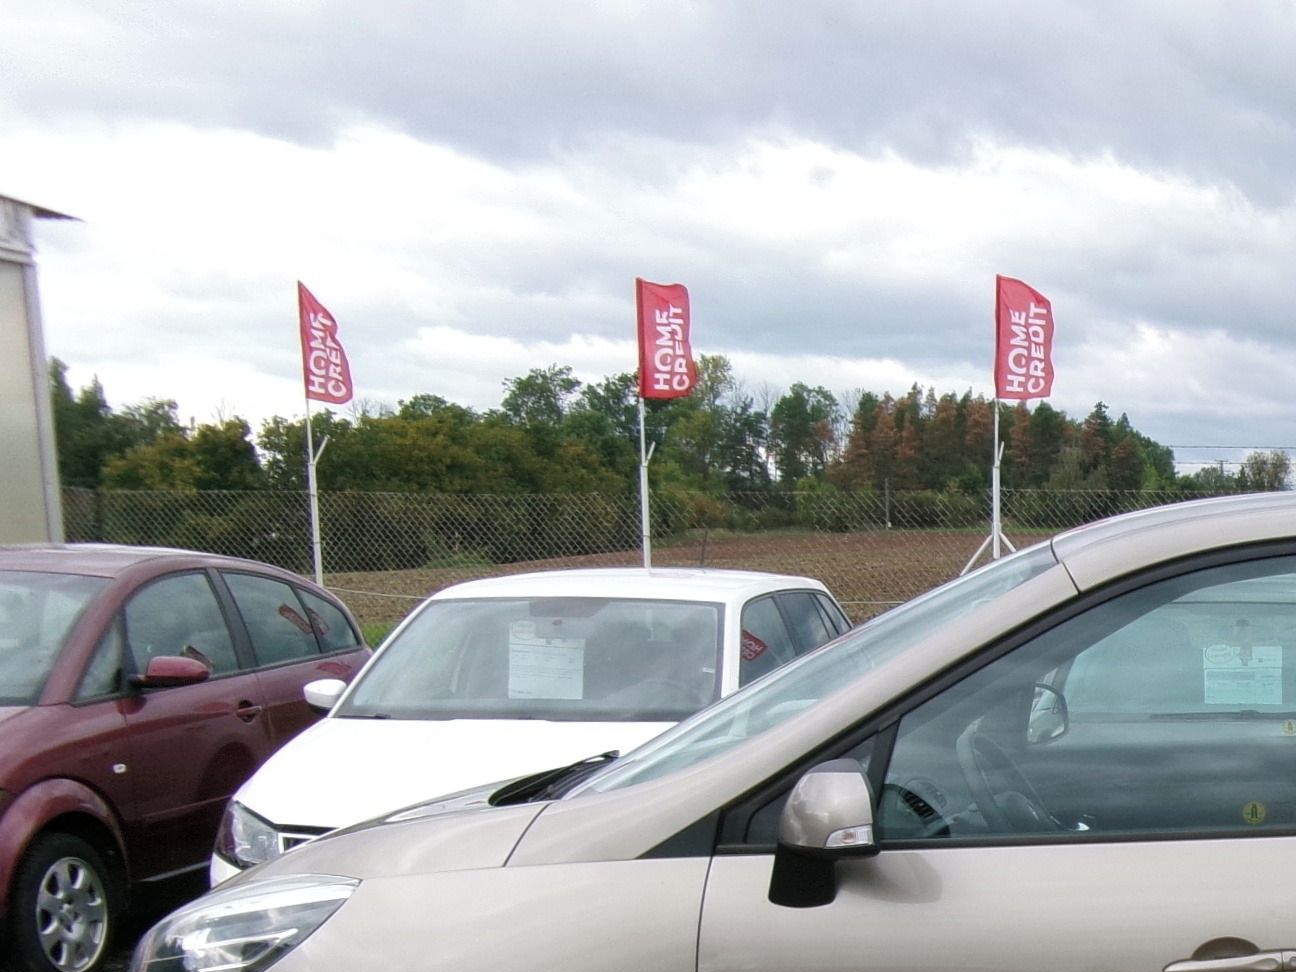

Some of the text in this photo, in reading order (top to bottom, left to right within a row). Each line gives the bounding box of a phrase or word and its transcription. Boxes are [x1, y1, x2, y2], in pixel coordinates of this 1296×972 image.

[654, 309, 674, 390] HOME
[1006, 309, 1029, 392] HOME
[1027, 302, 1047, 393] CREDIT
